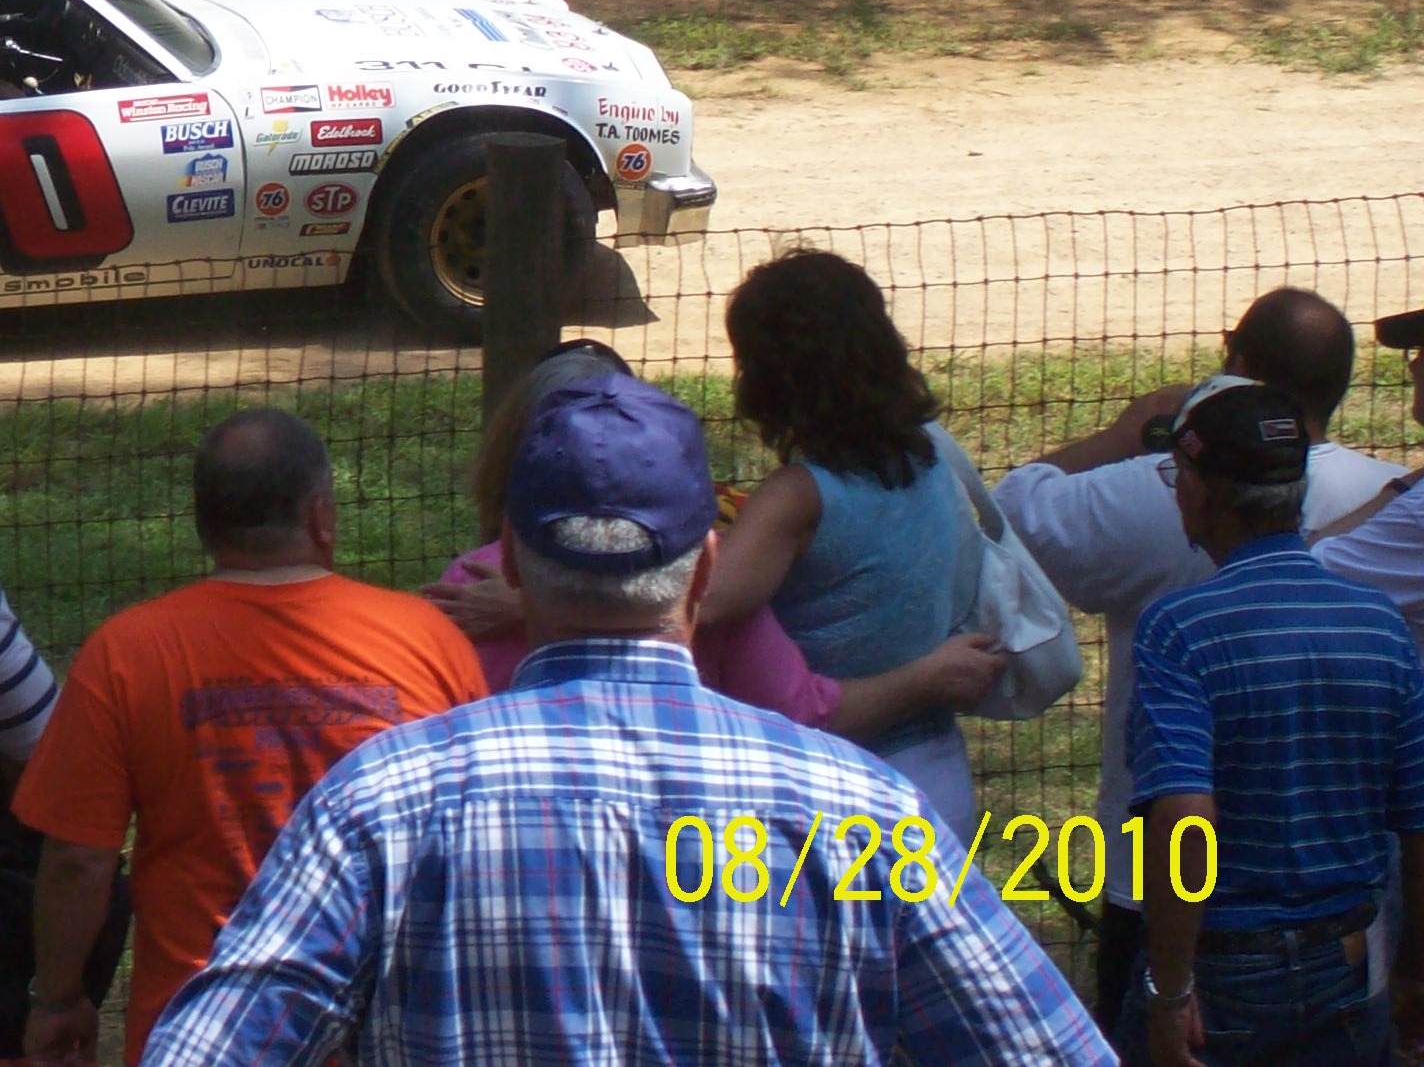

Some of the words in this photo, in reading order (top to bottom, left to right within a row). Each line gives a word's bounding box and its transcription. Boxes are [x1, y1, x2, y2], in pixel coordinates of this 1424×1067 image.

[266, 95, 318, 106] CHAMPION
[328, 85, 392, 107] Holley
[122, 106, 167, 119] Winston
[598, 97, 655, 122] Engine
[660, 106, 679, 125] by
[165, 121, 227, 142] BUSCH
[256, 128, 300, 144] Gatorade
[317, 123, 376, 140] Edelbrock
[595, 123, 620, 139] T.A.
[624, 125, 680, 145] TOOMES
[290, 151, 374, 171] MOROSO
[621, 151, 648, 171] 76
[172, 195, 230, 215] CLEVITE
[261, 189, 284, 207] 76
[311, 186, 352, 210] STP
[248, 256, 324, 269] UNOCAL
